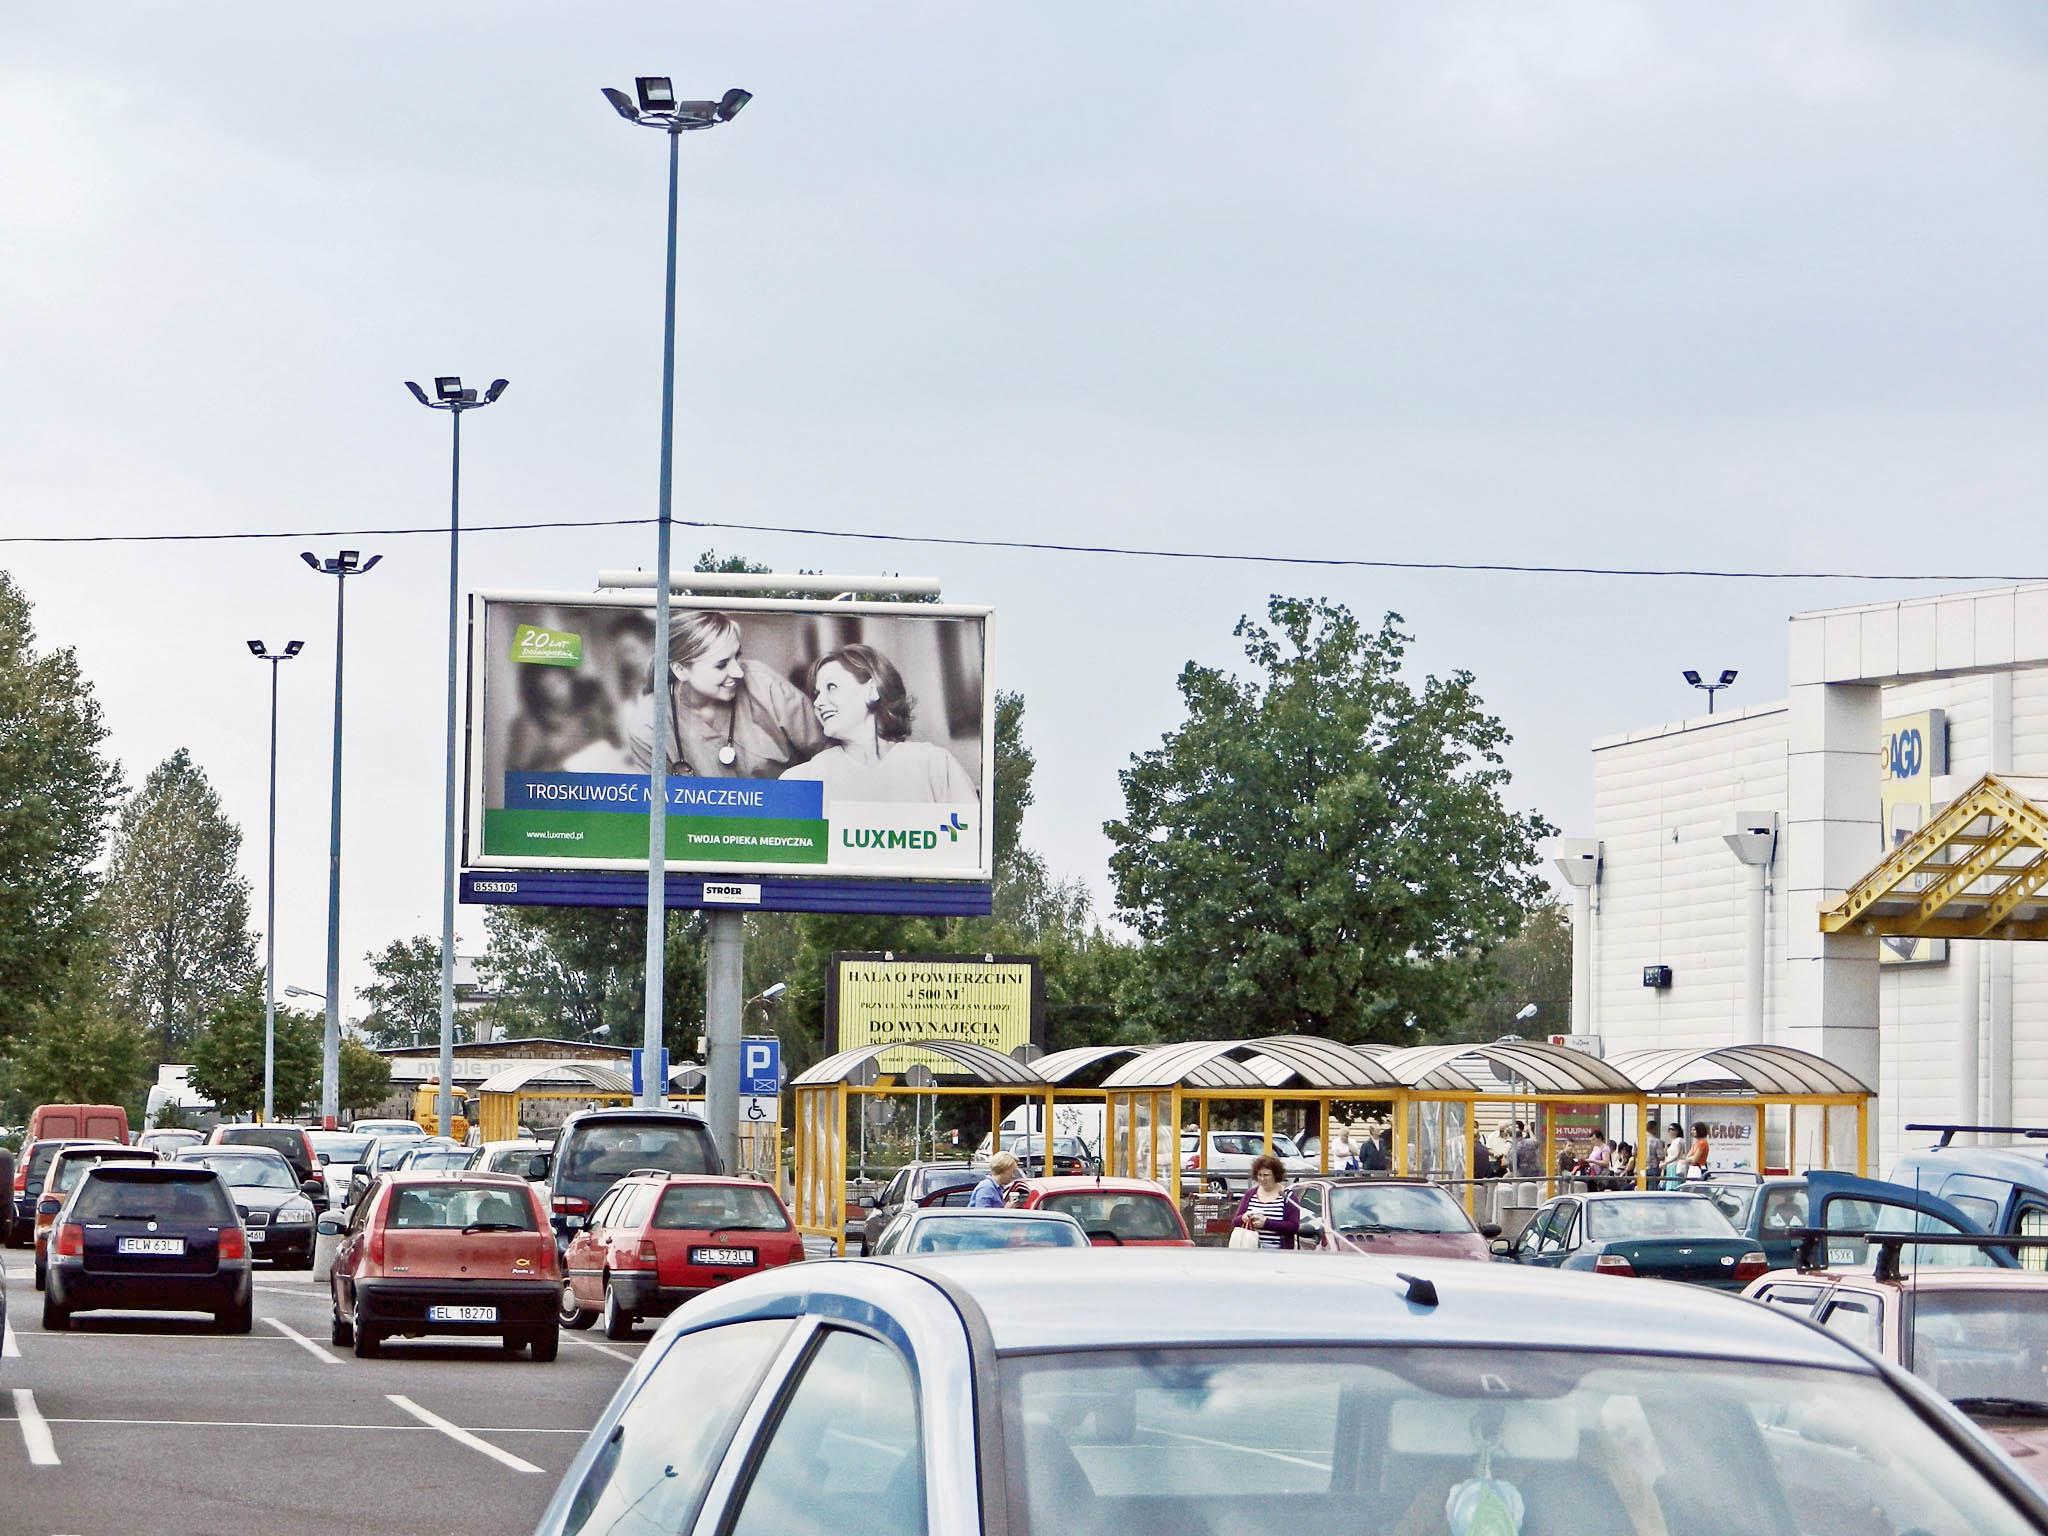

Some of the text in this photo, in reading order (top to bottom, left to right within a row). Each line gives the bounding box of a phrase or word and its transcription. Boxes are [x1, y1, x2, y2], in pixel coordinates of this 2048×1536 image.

[521, 630, 550, 648] 20
[1891, 728, 1922, 778] AGD
[526, 783, 639, 802] TROSKLIWOŚĆ
[674, 788, 764, 806] ZNACZENIE
[526, 830, 584, 840] www.luxmed.pl
[687, 834, 814, 847] TWOJA OPIEKA MEDYCZNA
[843, 829, 937, 849] LUXMED
[475, 883, 517, 892] 8553105
[849, 971, 1022, 984] HALA O POWIERZCHNI
[907, 990, 914, 999] 4
[918, 989, 941, 1000] 500
[870, 1021, 1000, 1037] DO WYNAJĘCIA
[747, 1045, 771, 1078] P
[127, 1239, 150, 1251] ELW
[700, 1249, 751, 1261] EL 573LL
[437, 1307, 493, 1320] EL 18270
